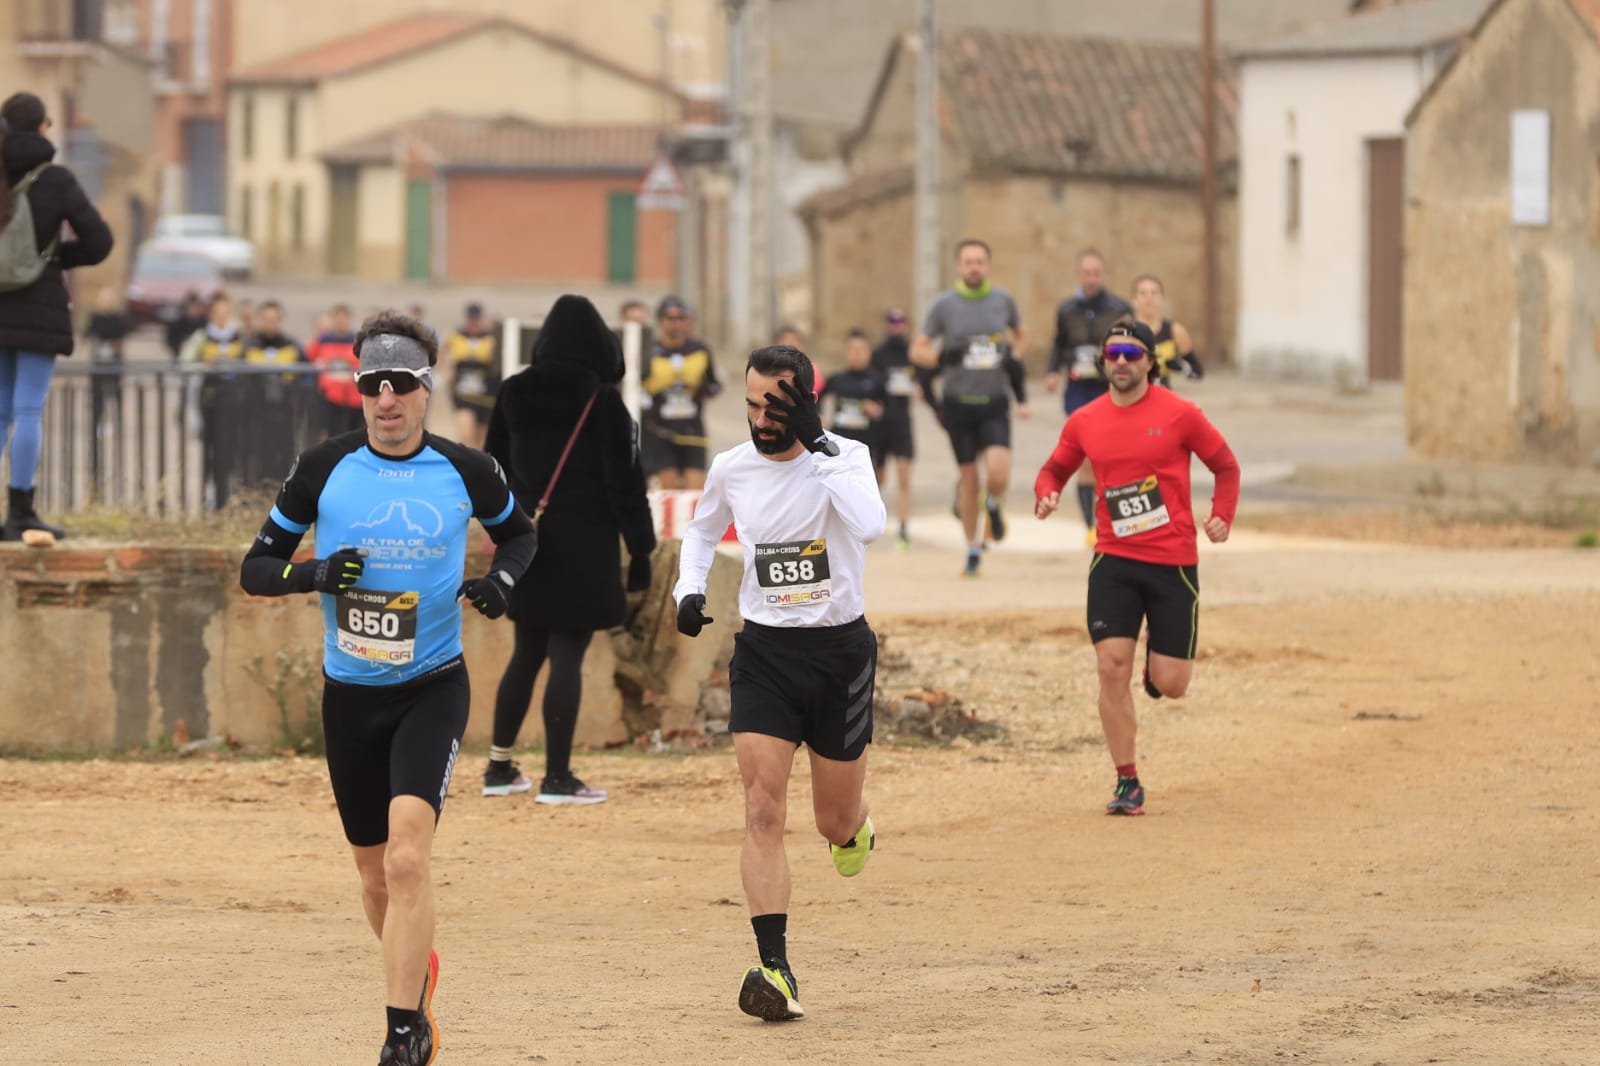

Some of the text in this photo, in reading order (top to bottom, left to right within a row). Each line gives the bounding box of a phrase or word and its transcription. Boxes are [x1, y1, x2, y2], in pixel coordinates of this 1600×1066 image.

[1118, 494, 1152, 518] 631
[361, 537, 425, 547] ULTRA DE
[780, 546, 800, 554] CROSS
[768, 559, 815, 584] 638
[363, 594, 388, 605] CROSS
[347, 607, 400, 638] 650
[339, 640, 412, 661] JOMISAGA
